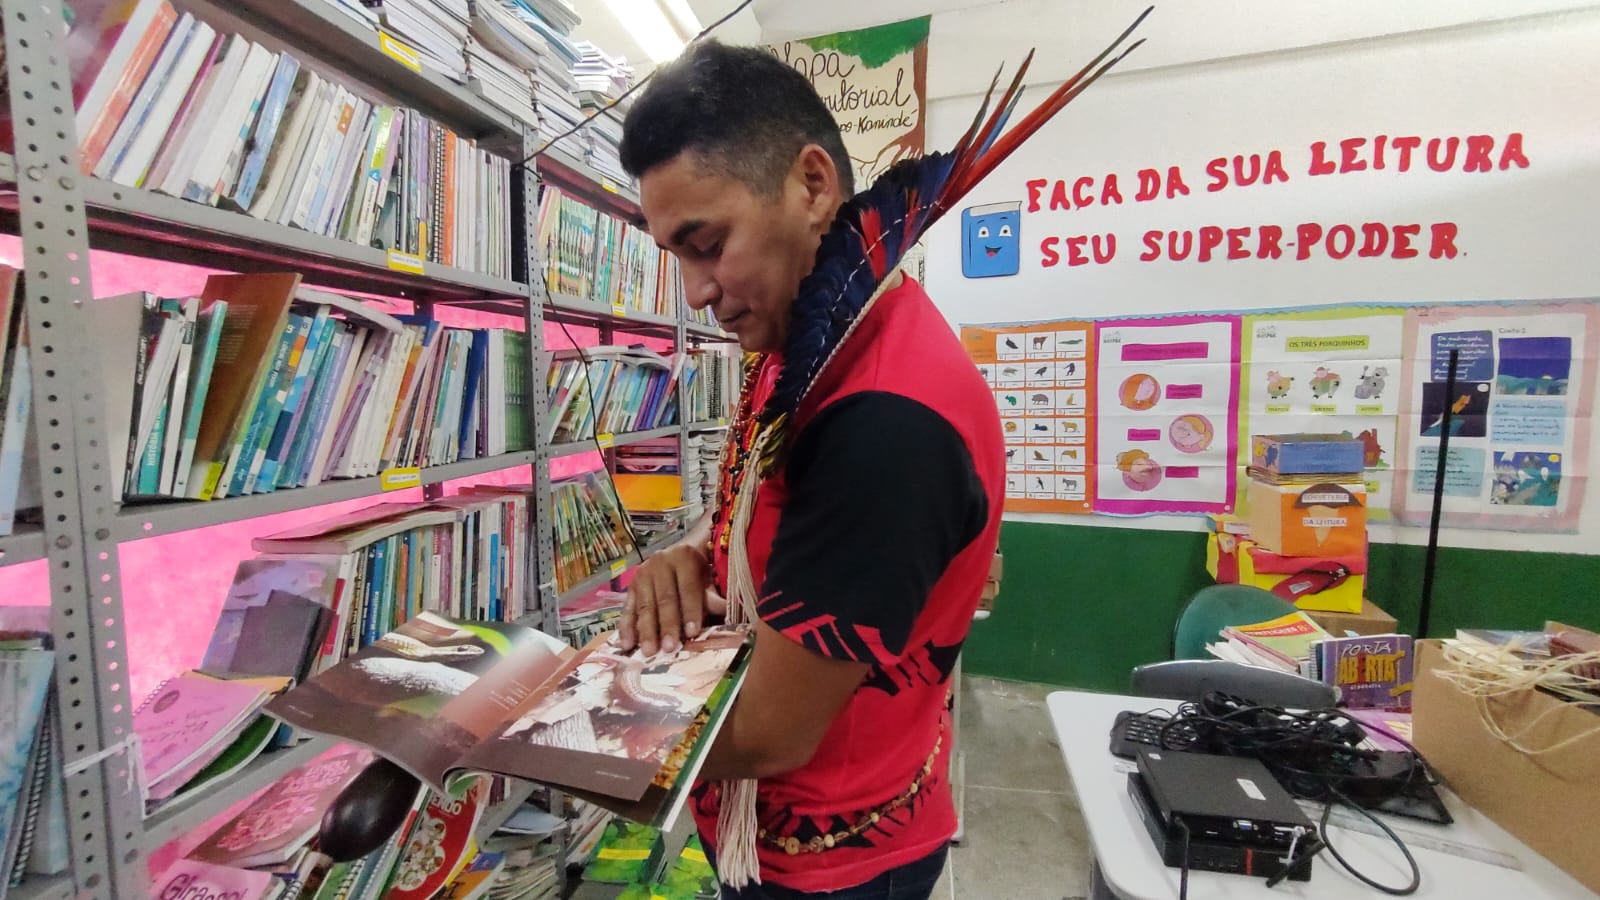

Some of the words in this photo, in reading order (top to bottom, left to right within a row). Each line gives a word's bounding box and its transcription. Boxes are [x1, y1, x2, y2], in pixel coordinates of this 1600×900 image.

[1134, 166, 1190, 202] DA
[1206, 150, 1289, 192] SUA
[1308, 132, 1530, 176] LEITURA
[1040, 233, 1117, 267] SEU
[1341, 640, 1392, 657] PORTA
